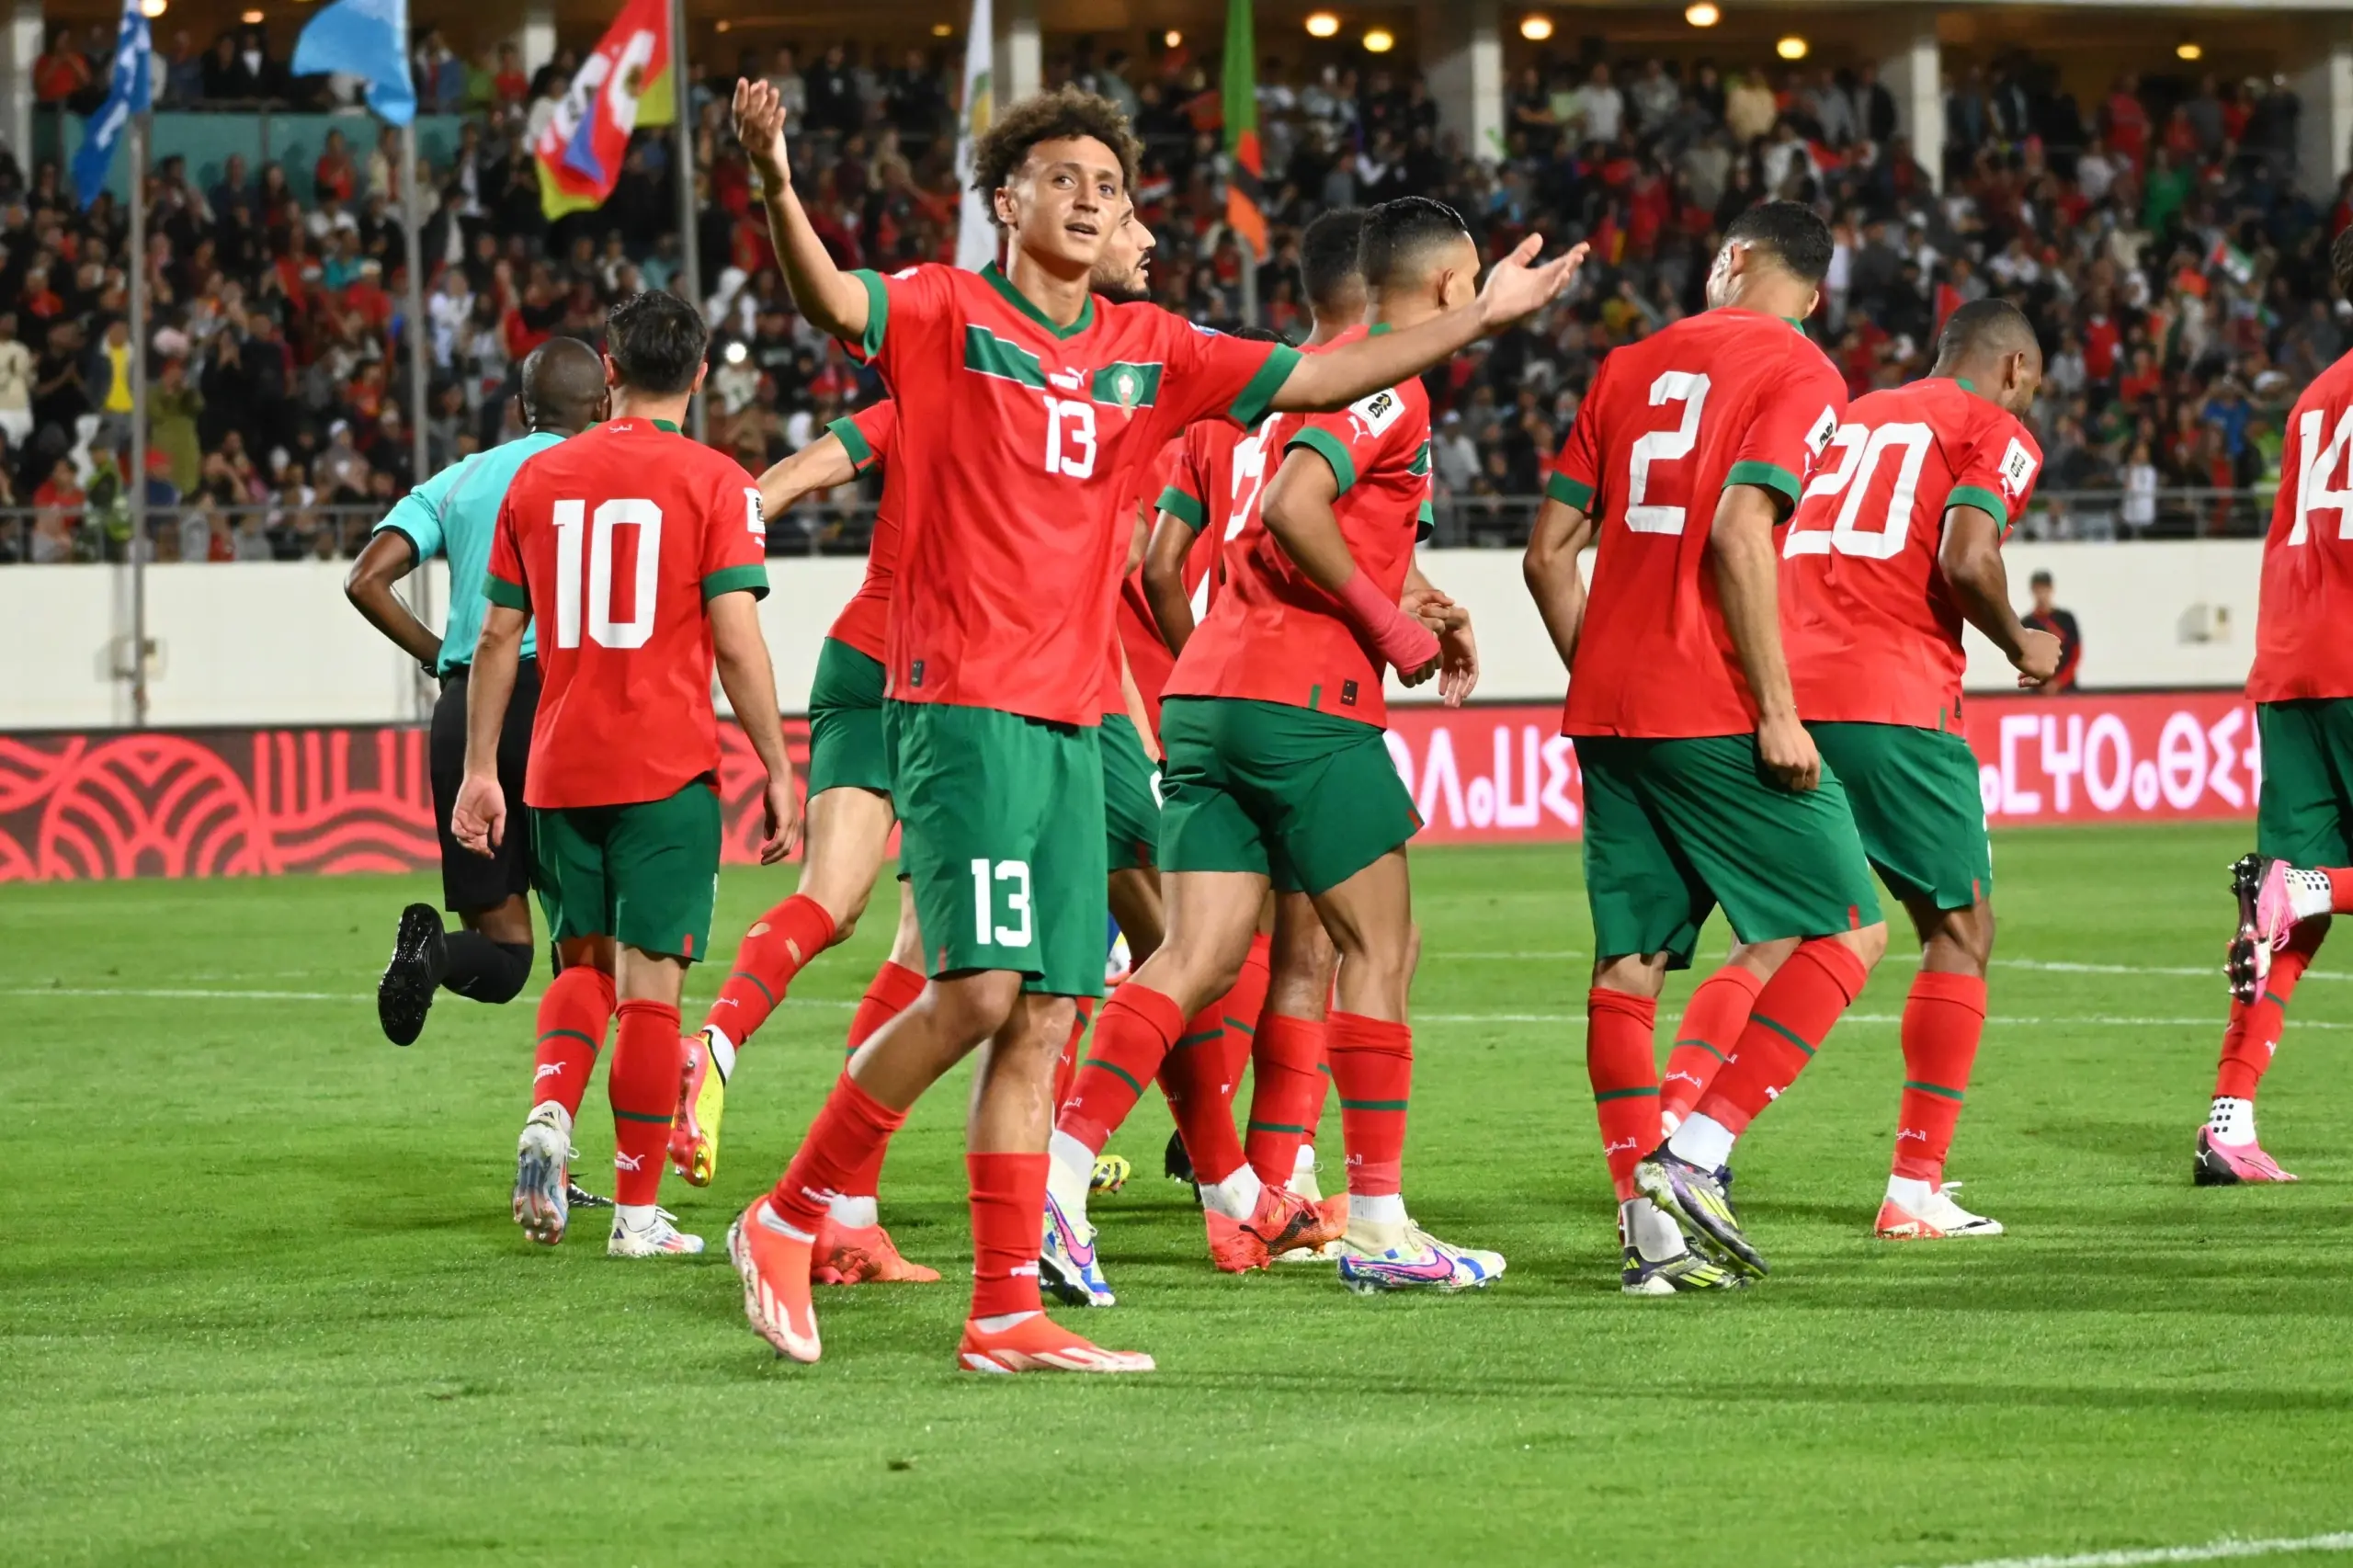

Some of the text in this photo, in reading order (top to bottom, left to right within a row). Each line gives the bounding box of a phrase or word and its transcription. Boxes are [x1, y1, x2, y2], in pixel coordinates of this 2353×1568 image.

[1043, 395, 1097, 478] 13
[1625, 371, 1711, 534] 2
[1783, 422, 1933, 559] 20
[2288, 404, 2353, 546] 14
[553, 498, 662, 648] 10
[971, 858, 1031, 948] 13
